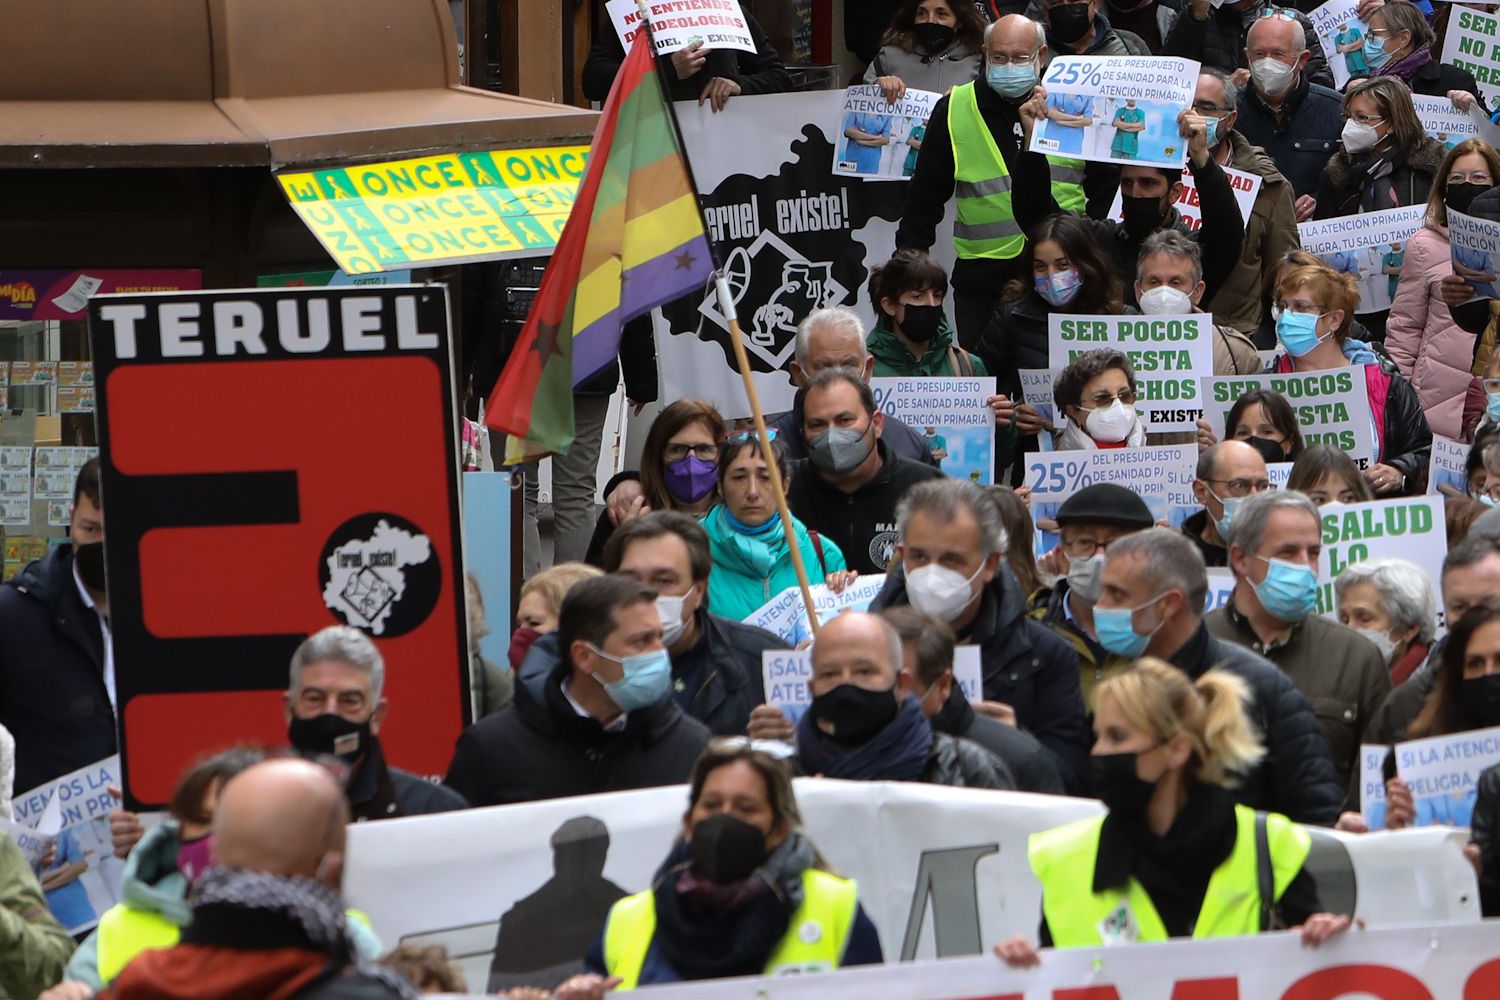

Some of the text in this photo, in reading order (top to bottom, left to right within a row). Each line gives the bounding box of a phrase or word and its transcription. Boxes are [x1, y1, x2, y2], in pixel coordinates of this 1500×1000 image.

[650, 0, 733, 16] ENTIENDE
[1459, 12, 1496, 36] SER
[1459, 37, 1484, 57] NO
[1047, 59, 1184, 87] 25% DEL PRESUPUESTO
[1102, 71, 1192, 90] DE SANIDAD PARA LA
[1099, 85, 1186, 103] ATENCIÓN PRIMARIA
[361, 151, 590, 197] ONCE ONC
[703, 187, 850, 241] eruel existe!
[1305, 211, 1420, 237] LA ATENCIÓN PRIMARIA
[405, 222, 508, 255] ONCE
[100, 295, 440, 360] TERUEL
[1061, 320, 1199, 341] SER POCOS
[897, 381, 981, 394] DEL PRESUPUESTO
[897, 397, 977, 410] DE SANIDAD PARA
[897, 411, 988, 426] ATENCIÓN PRIMARIA
[1029, 450, 1182, 494] 25% DEL PRESUPUESTO
[1093, 467, 1148, 482] DE SANIDAD
